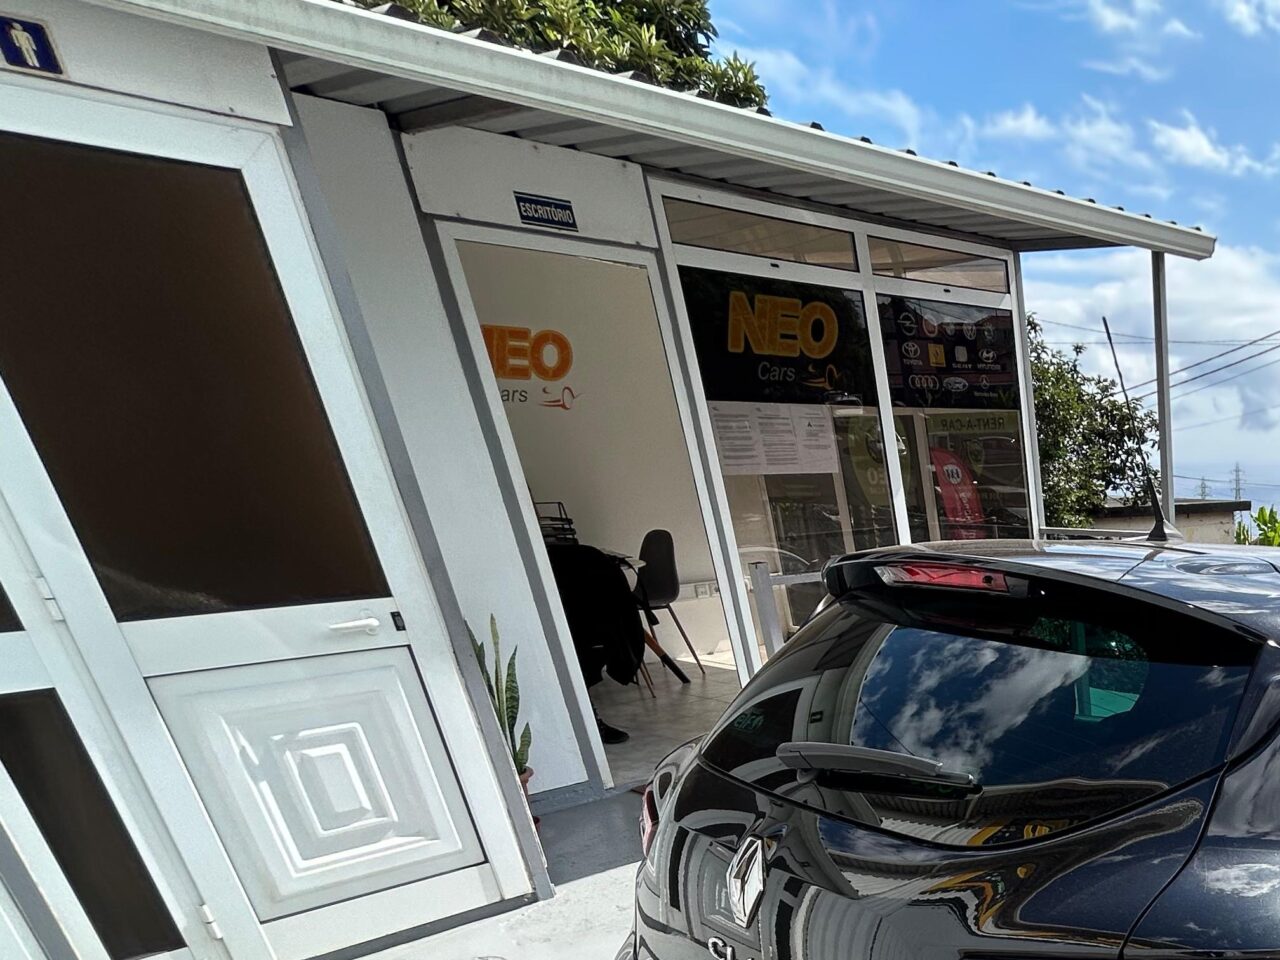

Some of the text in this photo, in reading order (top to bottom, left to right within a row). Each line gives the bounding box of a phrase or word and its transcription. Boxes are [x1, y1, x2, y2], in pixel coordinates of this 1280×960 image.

[520, 203, 573, 223] ESCRITÓRIO
[728, 291, 838, 359] NEO
[480, 324, 573, 381] EO
[758, 361, 796, 381] Cars
[500, 388, 528, 402] ars
